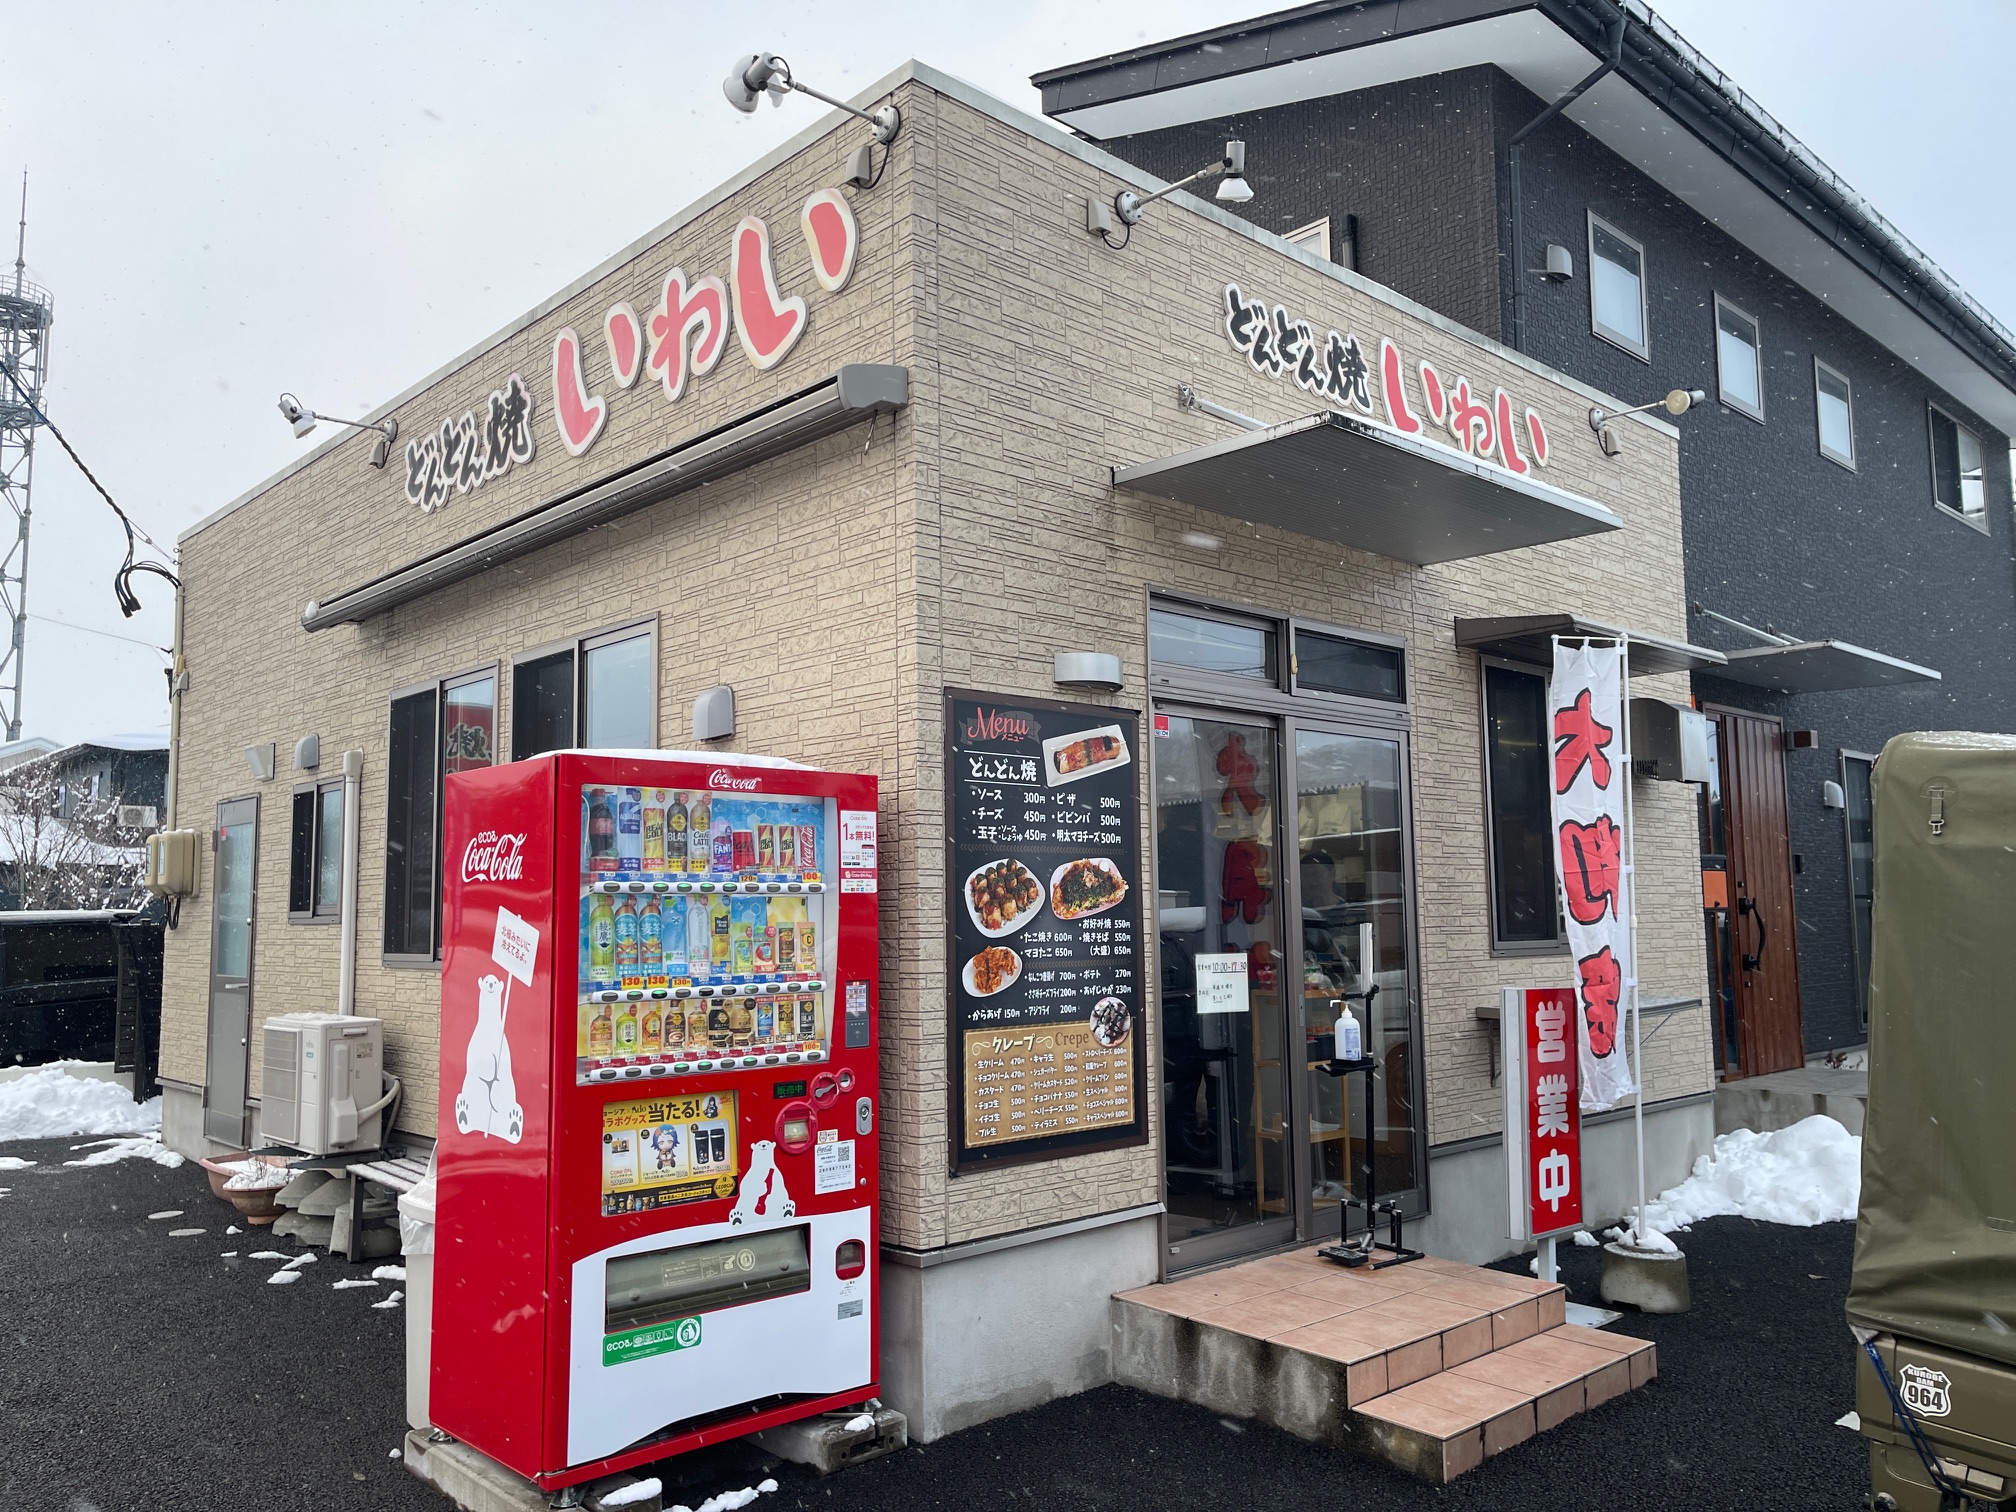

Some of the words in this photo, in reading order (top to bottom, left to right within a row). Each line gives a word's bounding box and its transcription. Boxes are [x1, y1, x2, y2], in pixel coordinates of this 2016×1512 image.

[967, 706, 1029, 739] Menu
[968, 755, 1037, 782] どんどん焼
[977, 788, 1003, 801] ソース
[1023, 792, 1046, 804] 300円
[1100, 797, 1121, 809] 500円
[977, 806, 1004, 820] チーズ
[1023, 811, 1046, 823] 450円
[1100, 815, 1121, 826] 500円
[977, 825, 998, 840] 玉子
[1001, 832, 1023, 842] しょうゆ
[1024, 829, 1047, 842] 450円
[1001, 825, 1017, 833] ソース
[1056, 829, 1100, 842] 明太マヨチーズ
[1101, 832, 1122, 844] 500円
[461, 832, 527, 883] Coca-Cola
[1082, 918, 1112, 929] お好み焼
[1114, 919, 1131, 929] 550円
[501, 925, 531, 953] 北極みたいに
[1023, 931, 1052, 944] たこ焼き
[1054, 932, 1073, 943] 600円
[1082, 931, 1110, 943] 焼きそば
[1114, 932, 1131, 942] 550円
[500, 938, 527, 965] 冷えてるよ。
[1025, 947, 1053, 959] マヨたこ
[1054, 947, 1073, 957] 650円
[1114, 946, 1132, 956] 650円
[1059, 970, 1076, 981] 700円
[1082, 969, 1101, 980] ポテト
[1114, 968, 1132, 978] 270円
[1060, 987, 1077, 998] 200円
[1083, 984, 1114, 996] あげじゃが
[1115, 984, 1132, 994] 230円
[972, 1007, 1002, 1022] からあげ
[1004, 1008, 1021, 1019] 150円
[1028, 1005, 1050, 1017] アジフライ
[1059, 1004, 1077, 1015] 200円
[992, 1033, 1036, 1054] クレープ
[1055, 1031, 1090, 1049] Crepe
[777, 1084, 803, 1096] 販売中
[648, 1099, 700, 1123] 当たる!
[1535, 1000, 1570, 1213] 営業中
[1907, 1367, 1944, 1383] KUROBE
[1916, 1377, 1934, 1388] DAM
[1908, 1384, 1943, 1410] 964
